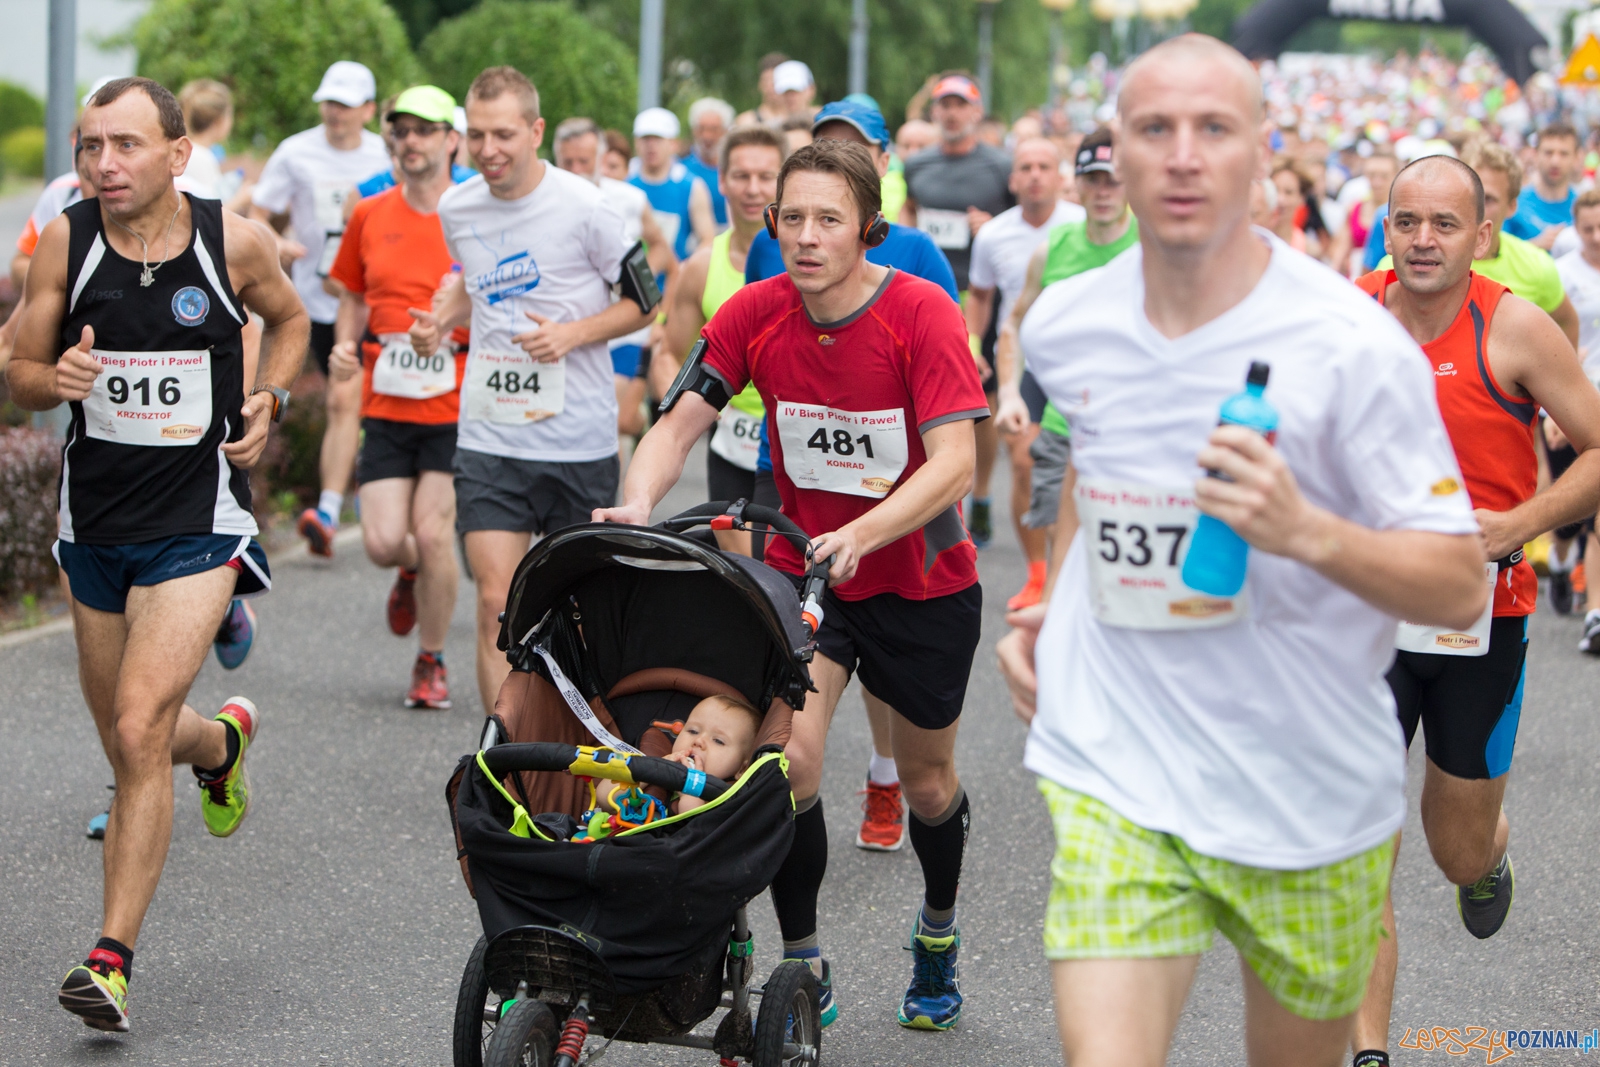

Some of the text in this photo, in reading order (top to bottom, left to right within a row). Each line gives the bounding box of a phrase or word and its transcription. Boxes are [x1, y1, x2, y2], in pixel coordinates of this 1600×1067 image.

[101, 356, 126, 368] Bieg
[129, 357, 158, 367] Piotr
[161, 357, 165, 366] i
[169, 355, 203, 366] Paweł
[388, 349, 444, 373] 1000
[107, 376, 181, 406] 916
[486, 370, 541, 393] 484
[117, 410, 172, 420] KRZYSZTOF
[785, 407, 796, 416] IV
[799, 409, 824, 420] Bieg
[827, 411, 851, 423] Piotr
[861, 415, 897, 425] Paweł
[807, 427, 874, 459] 481
[826, 459, 865, 470] KONRAD
[1099, 521, 1187, 566] 537
[1459, 637, 1478, 645] Paweł
